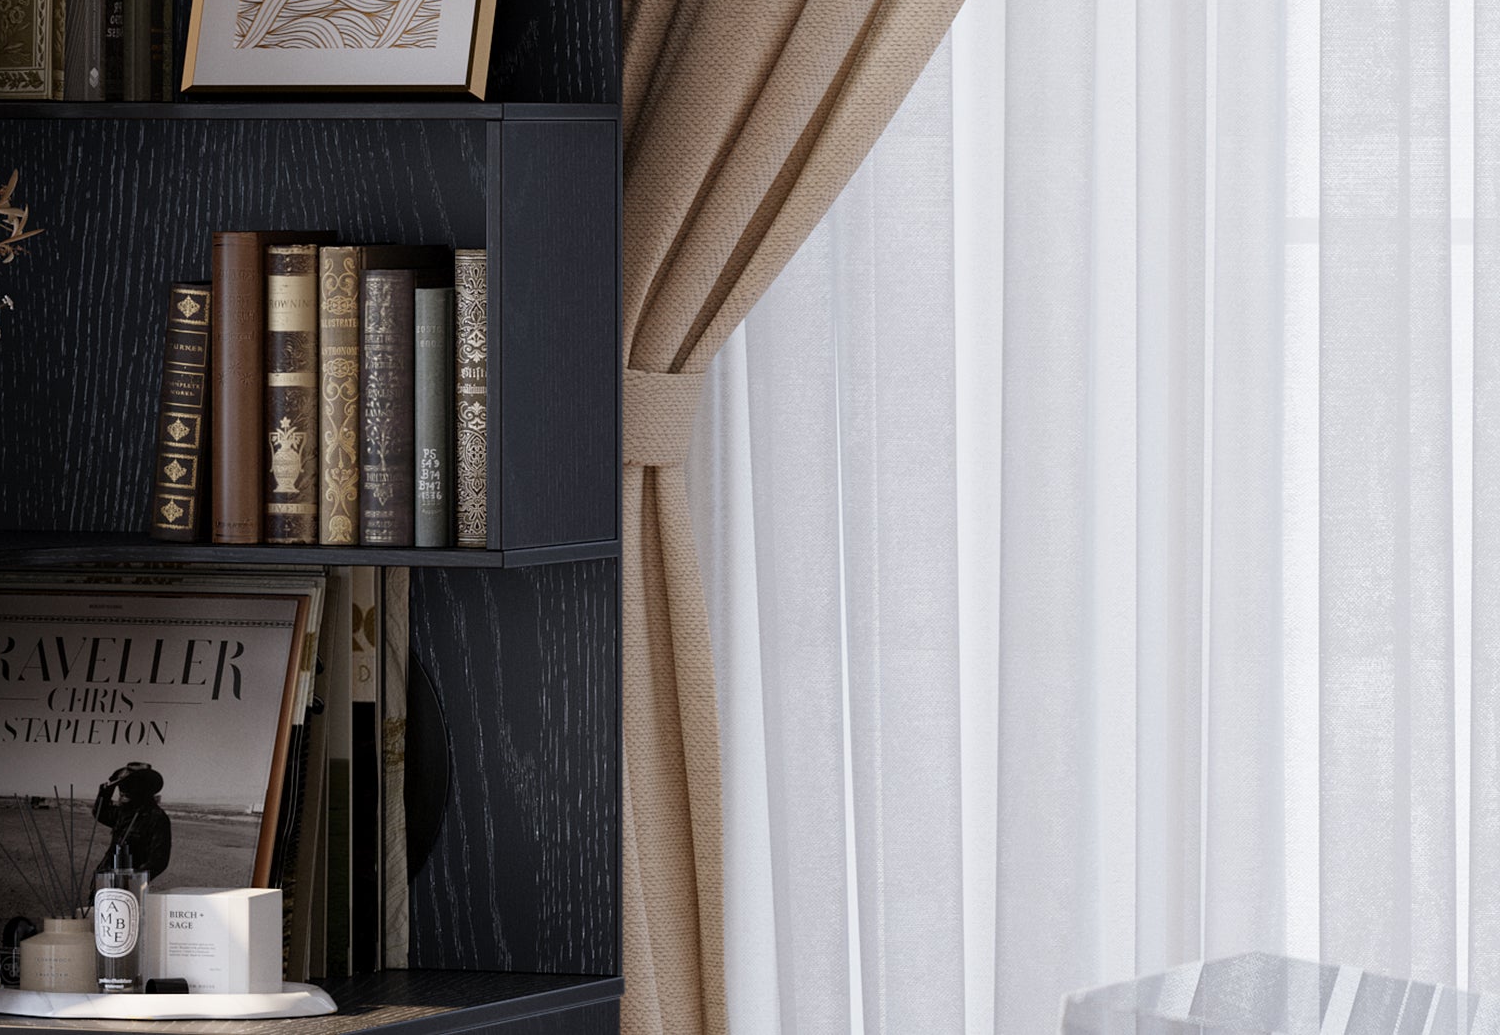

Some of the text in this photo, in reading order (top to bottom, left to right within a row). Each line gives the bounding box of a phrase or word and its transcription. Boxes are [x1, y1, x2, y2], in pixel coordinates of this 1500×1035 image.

[422, 448, 437, 460] PS
[420, 468, 440, 480] B74
[418, 480, 441, 491] B747
[47, 686, 136, 714] CHRIS
[1, 717, 169, 746] STAPLETON
[169, 910, 197, 919] BIRCH
[169, 921, 194, 929] SAGE
